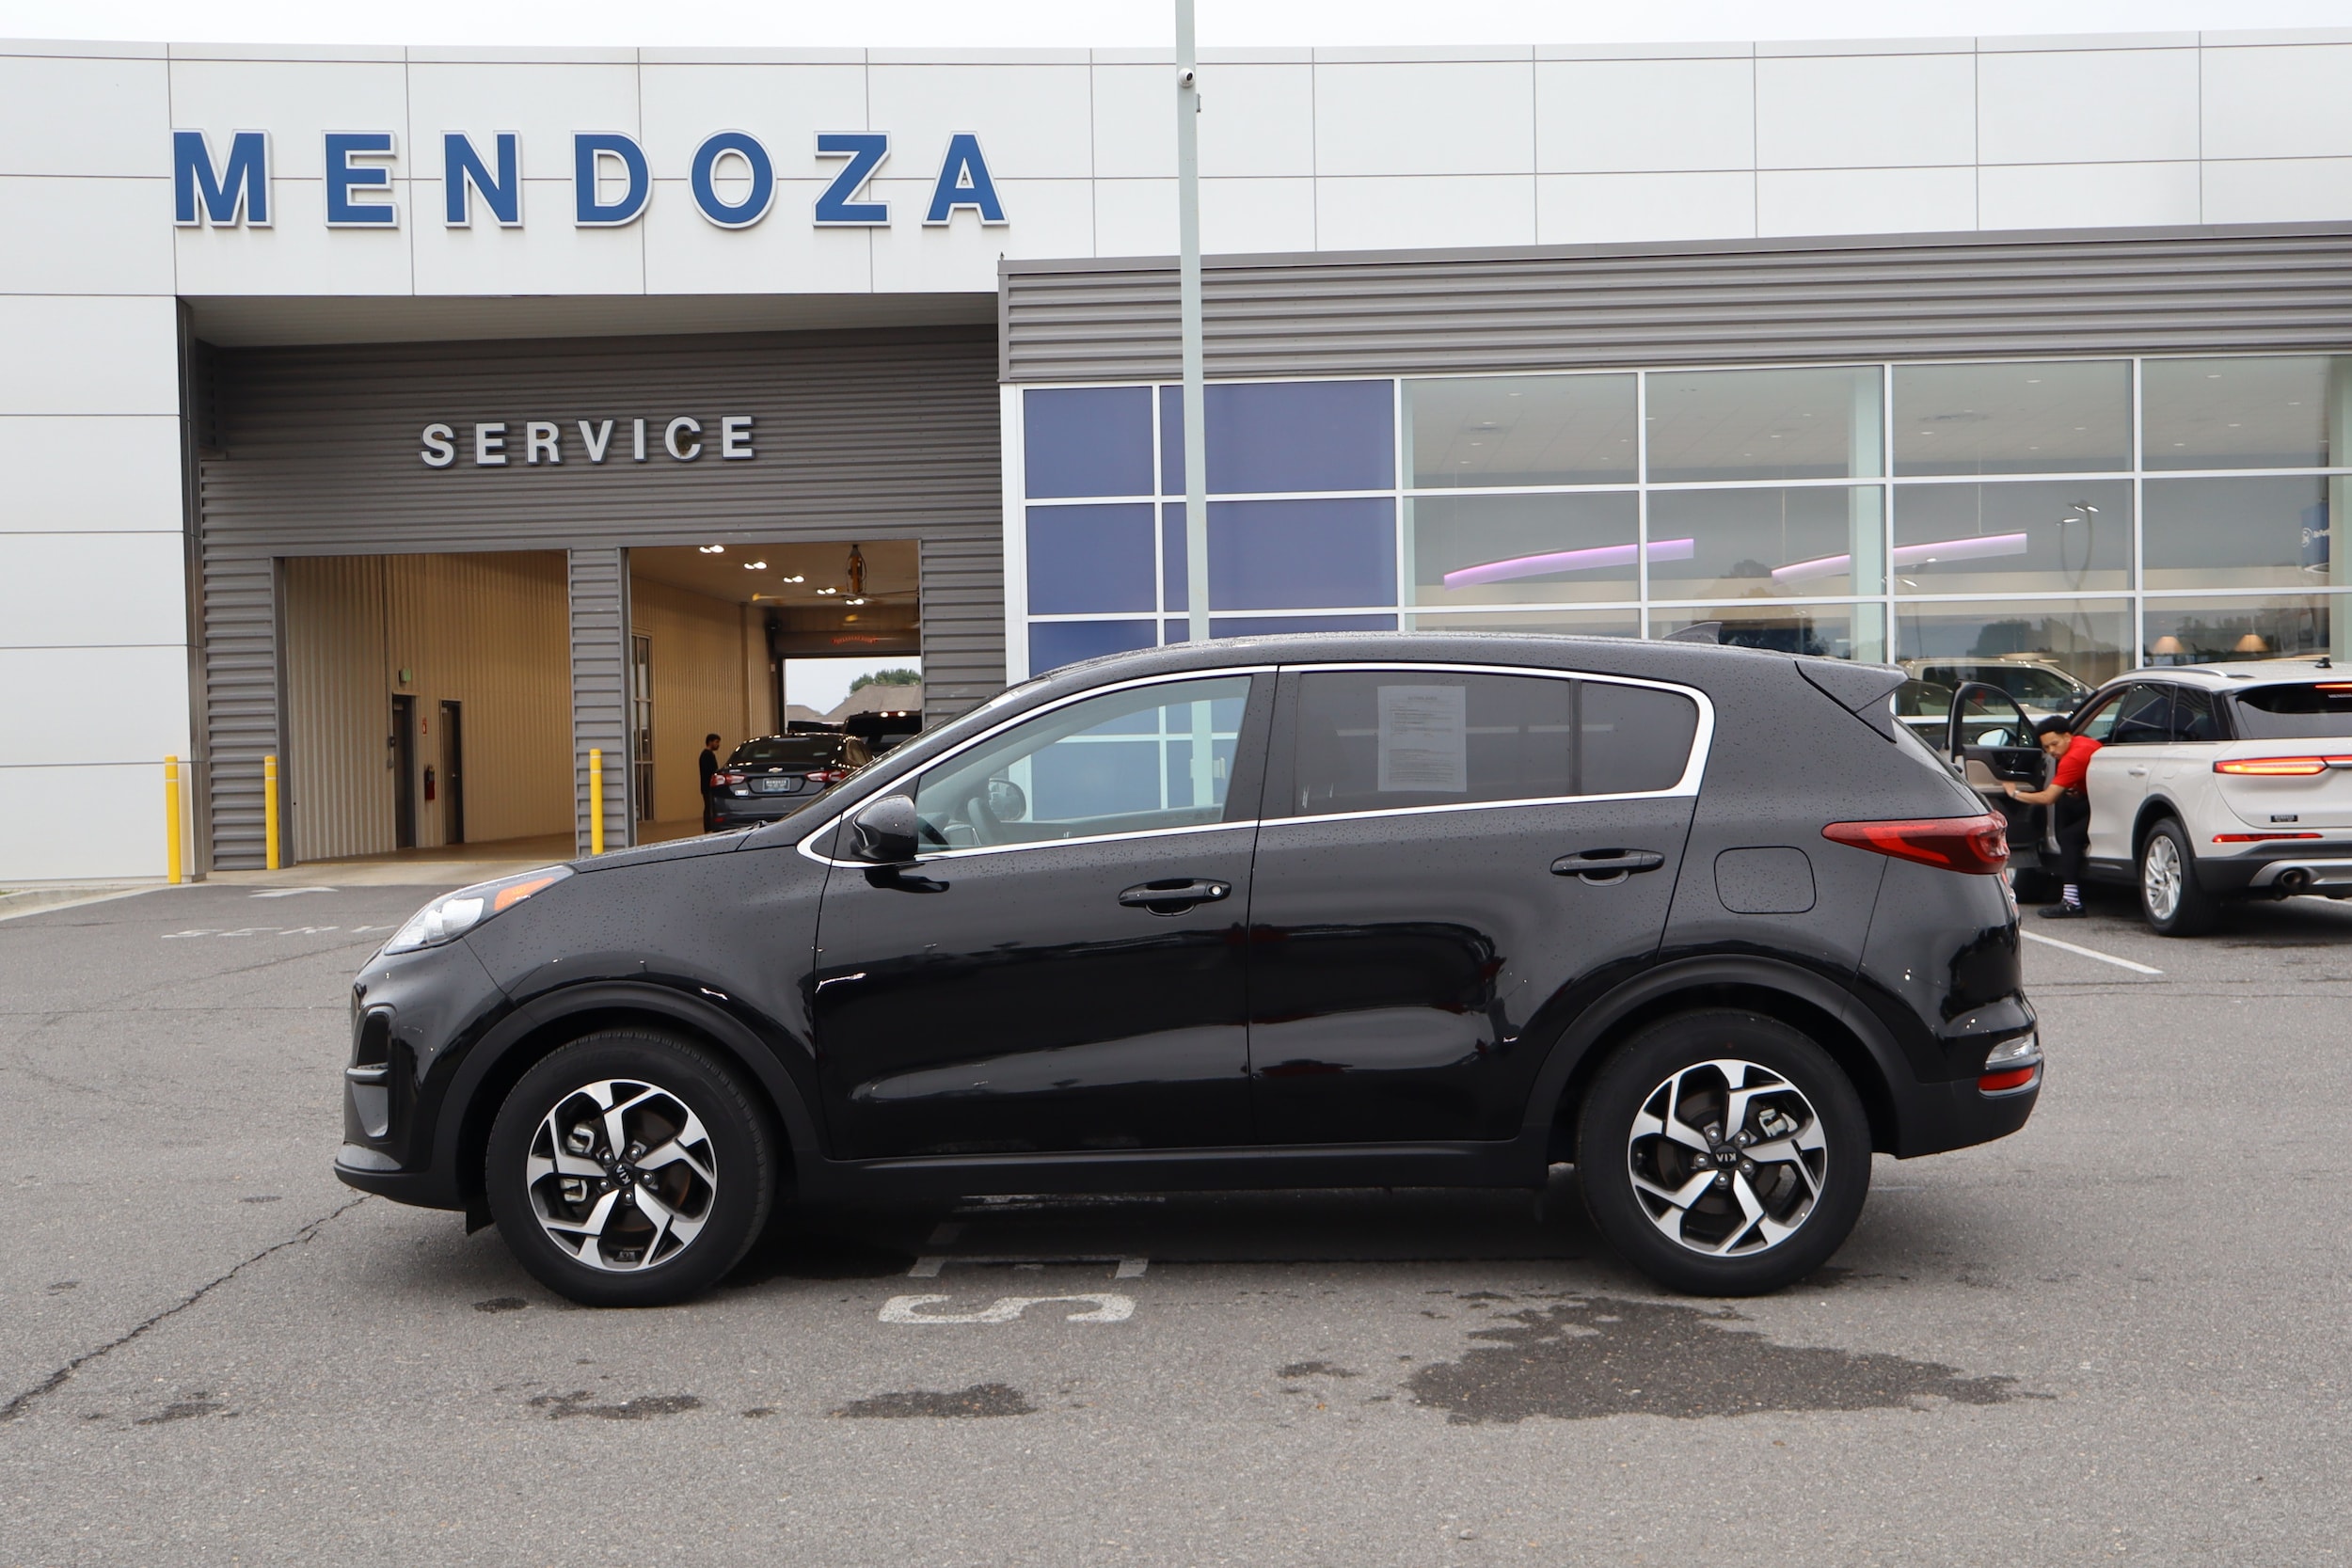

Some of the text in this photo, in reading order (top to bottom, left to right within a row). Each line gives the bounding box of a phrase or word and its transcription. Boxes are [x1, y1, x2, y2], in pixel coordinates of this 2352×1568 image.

[170, 128, 1010, 230] MENDOZA
[420, 414, 755, 468] SERVICE
[615, 1164, 631, 1185] KIA
[1715, 1152, 1738, 1163] KIA
